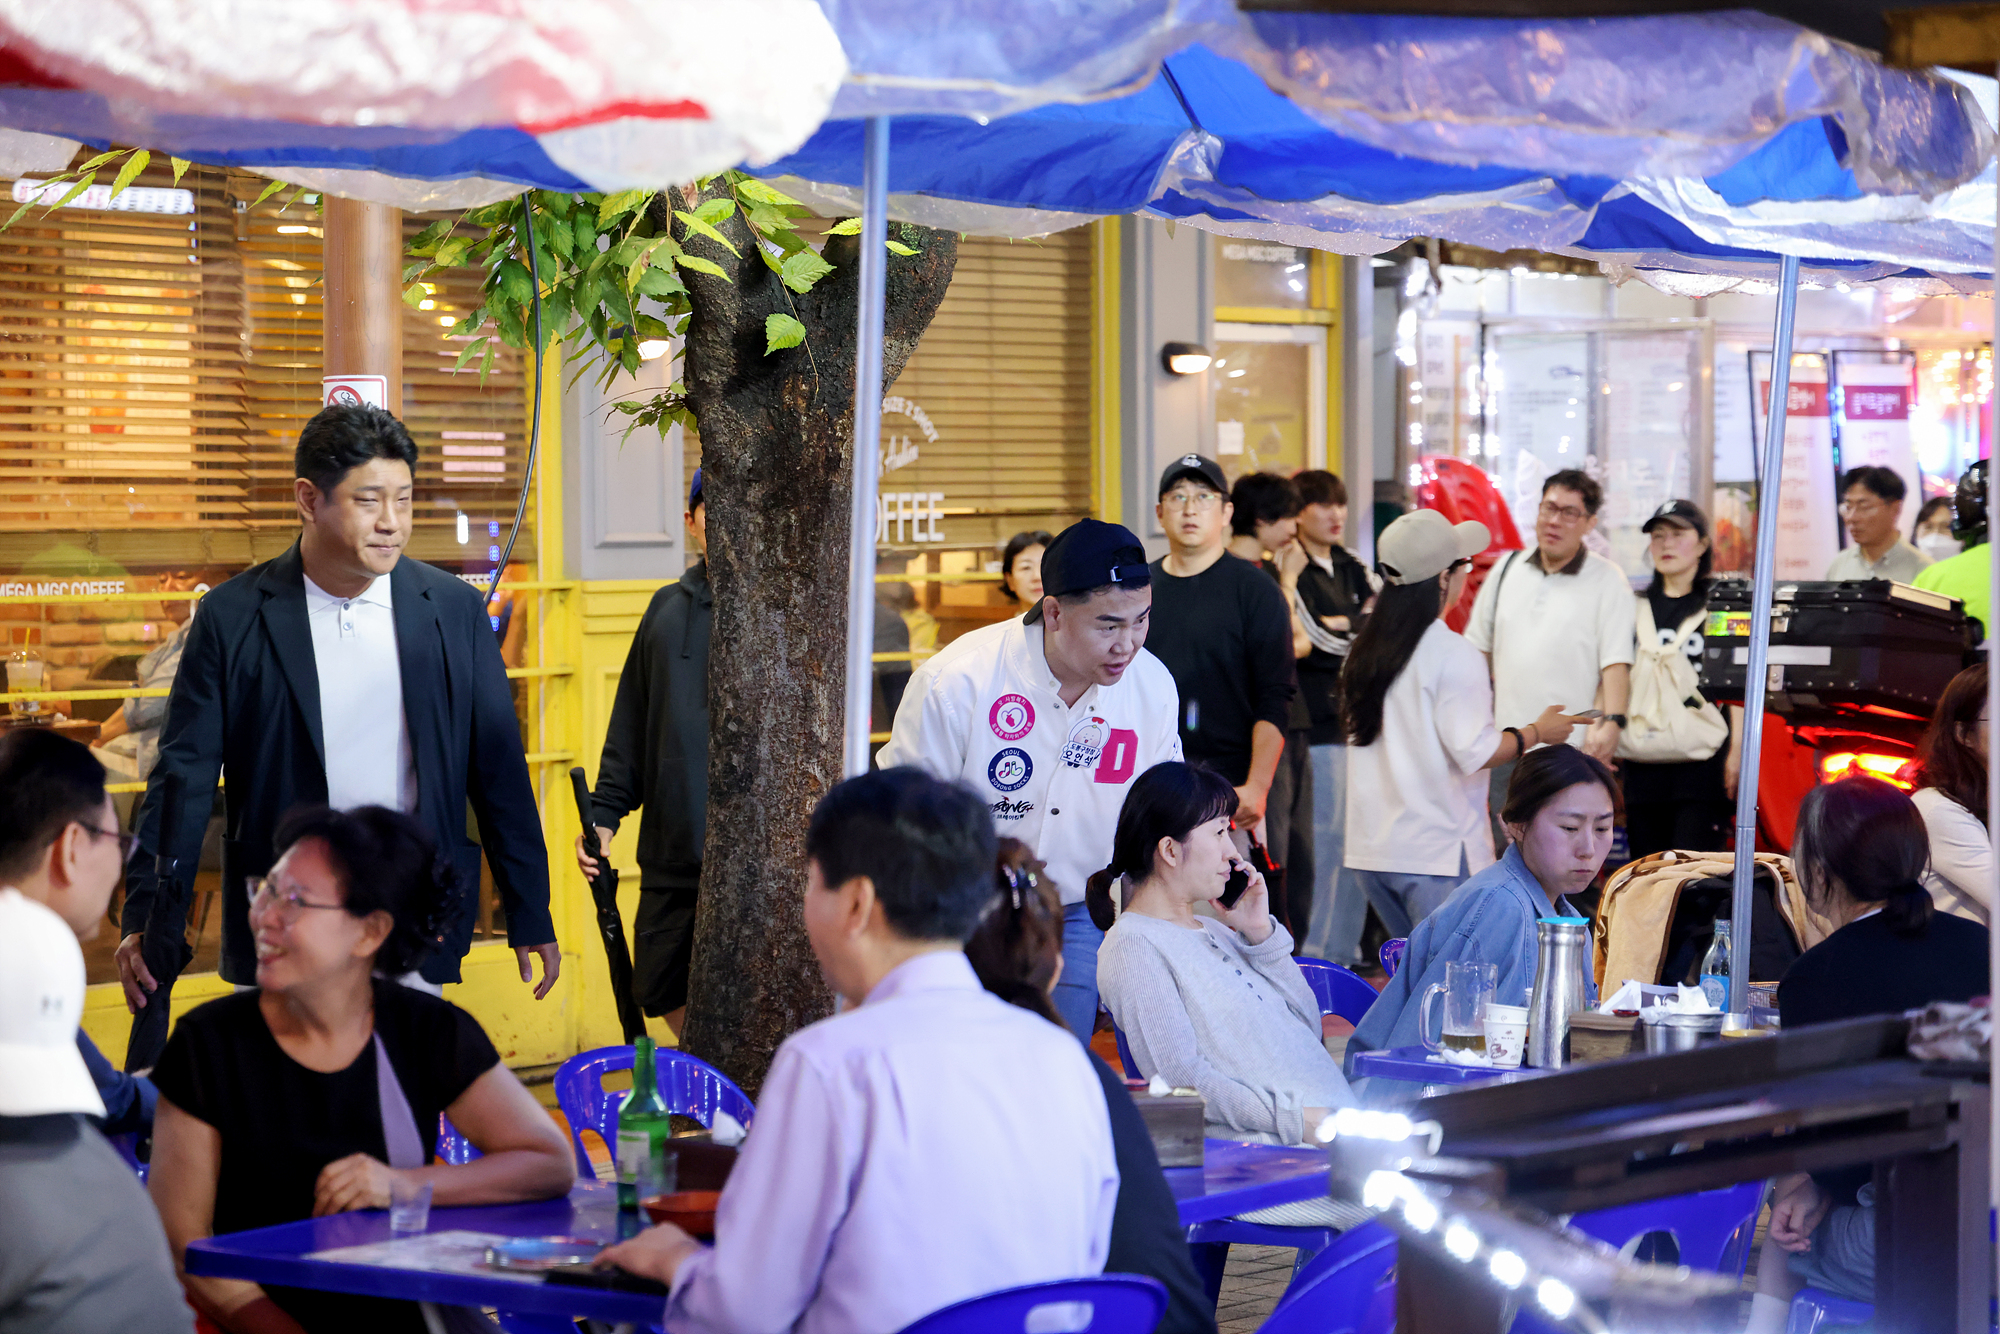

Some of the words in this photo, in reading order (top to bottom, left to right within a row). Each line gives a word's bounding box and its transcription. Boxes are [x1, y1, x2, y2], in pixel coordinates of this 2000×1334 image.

[875, 492, 945, 542] FFEE
[1001, 749, 1020, 757] SEOUL
[1093, 728, 1139, 784] D
[1013, 775, 1029, 790] SOCKS
